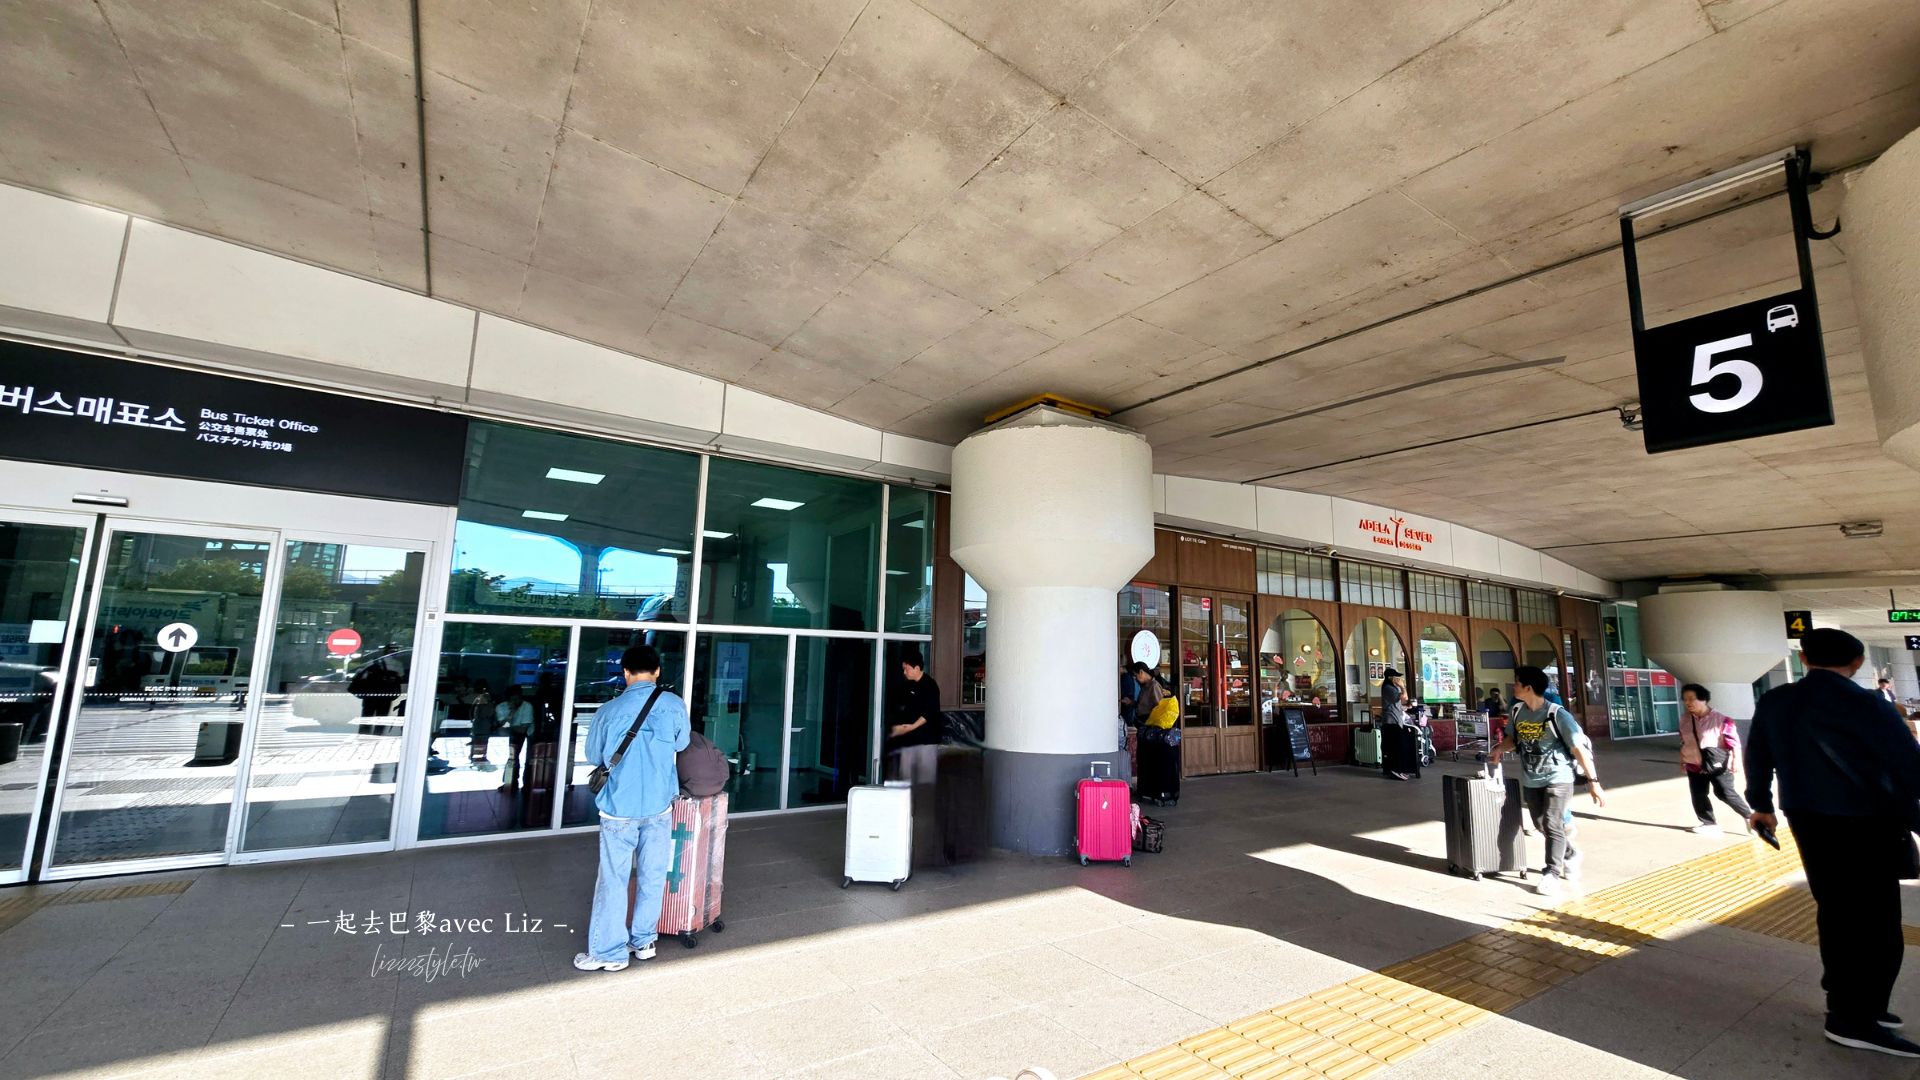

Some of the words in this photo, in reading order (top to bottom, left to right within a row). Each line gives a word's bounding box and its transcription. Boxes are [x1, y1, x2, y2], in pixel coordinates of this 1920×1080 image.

[1689, 333, 1764, 413] 5
[0, 384, 187, 432] 버스매표소
[198, 421, 269, 439] 公交车售票处
[200, 408, 228, 421] Bus
[233, 412, 275, 427] Ticket
[278, 419, 319, 433] Office
[196, 433, 293, 452] バスチケット売り場
[1359, 519, 1391, 535] ADELA
[1404, 527, 1433, 543] SEVEN
[1790, 617, 1806, 632] 4
